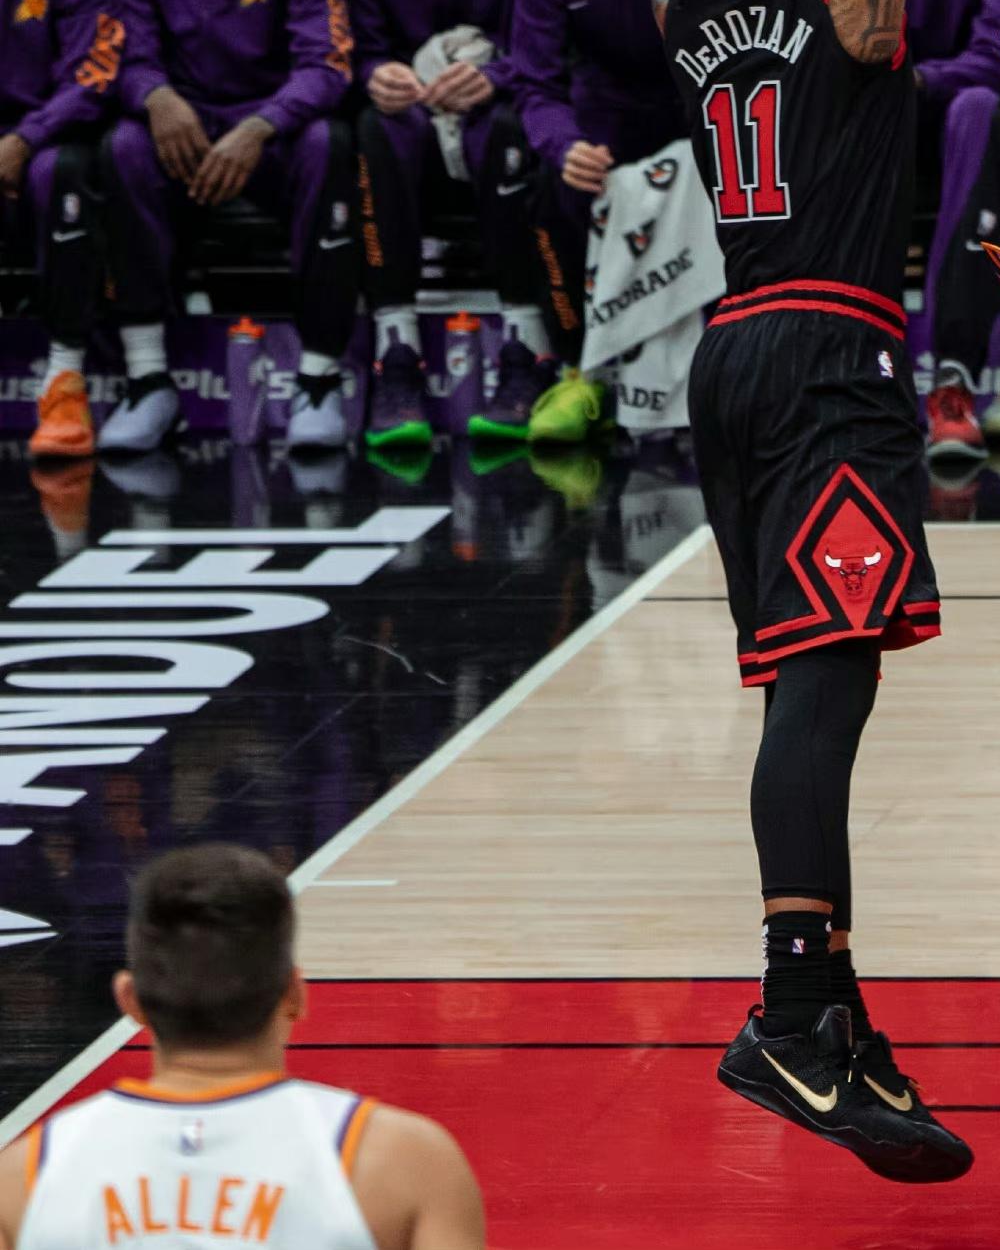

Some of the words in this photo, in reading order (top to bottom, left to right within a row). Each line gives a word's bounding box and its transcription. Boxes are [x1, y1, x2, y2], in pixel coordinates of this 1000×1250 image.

[675, 5, 814, 87] DeROZAN
[701, 79, 792, 224] 11
[586, 246, 694, 330] ATORADE
[102, 1174, 287, 1246] ALLEN
